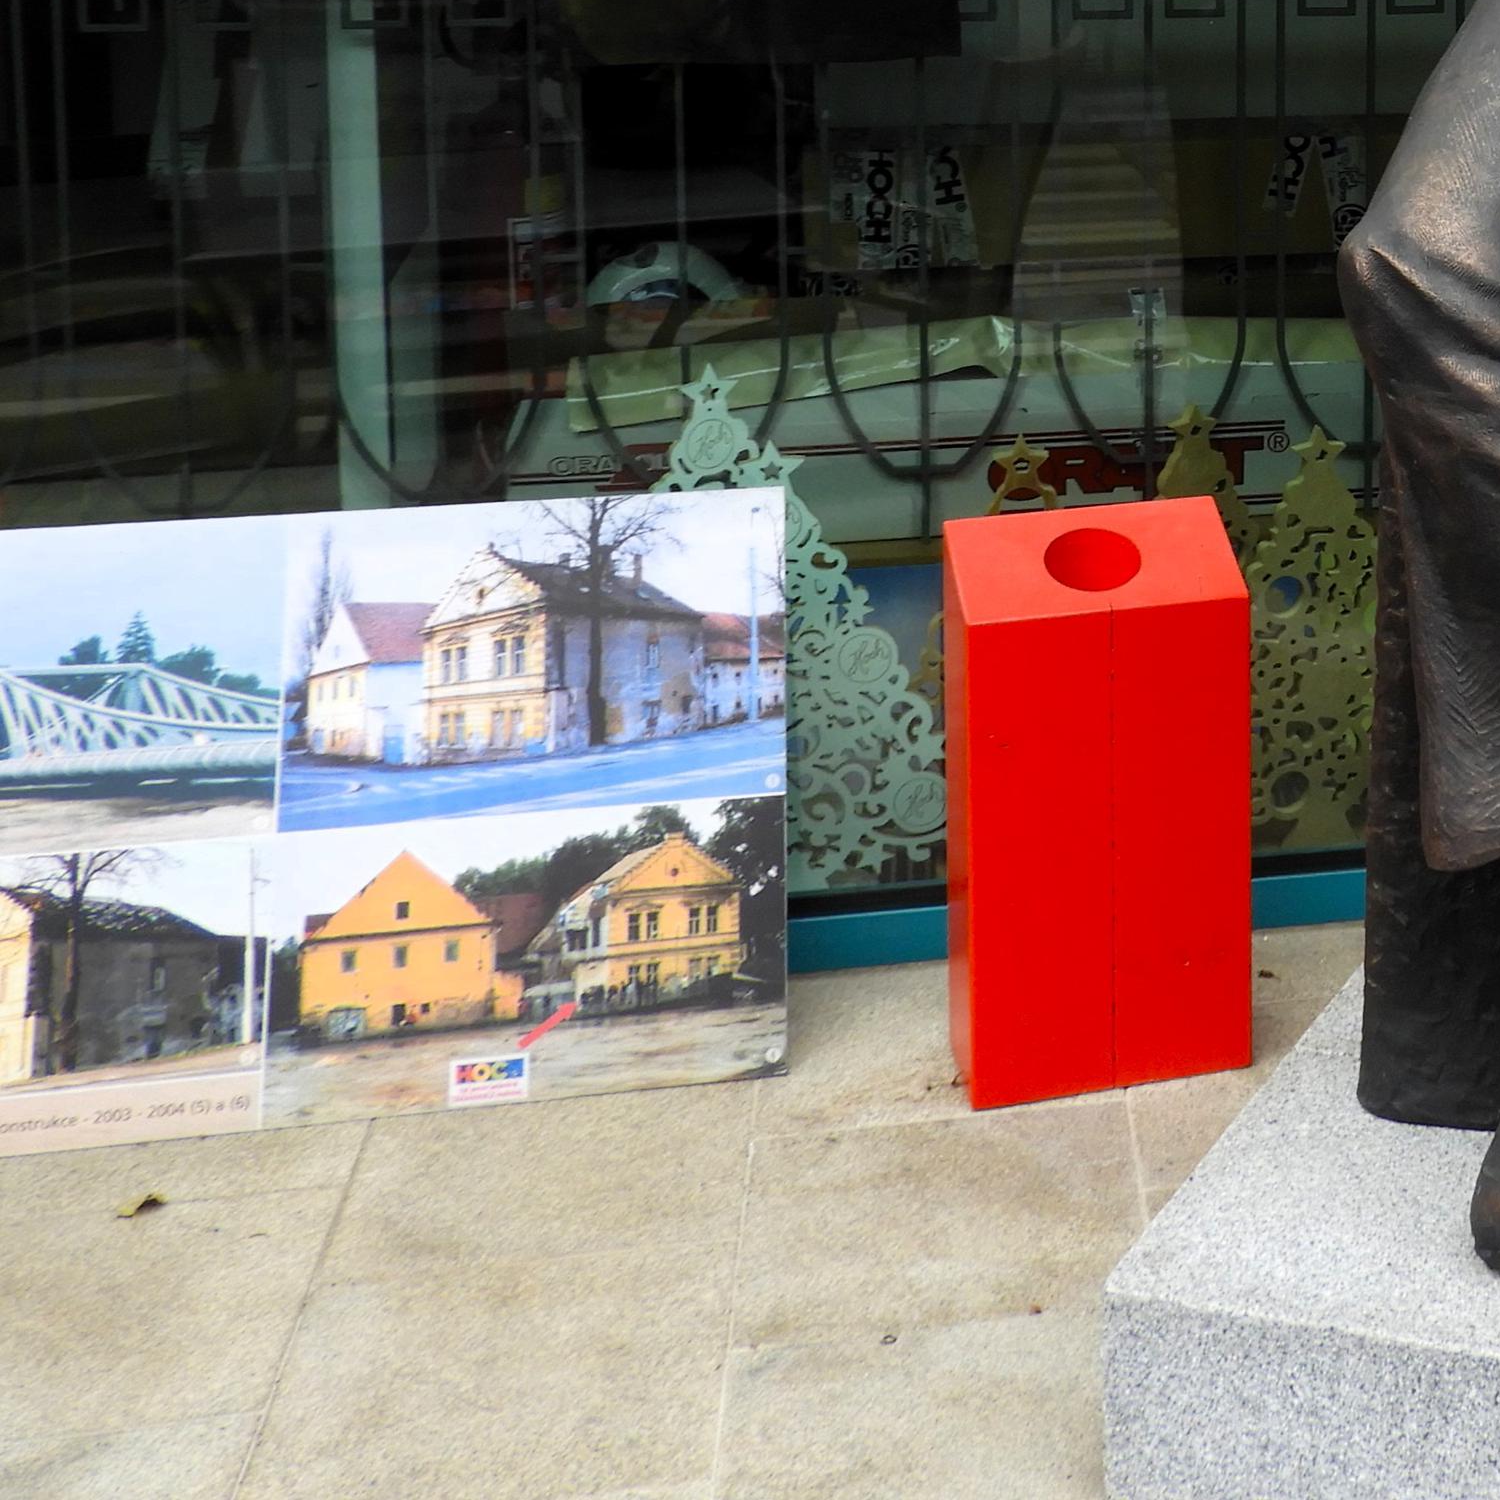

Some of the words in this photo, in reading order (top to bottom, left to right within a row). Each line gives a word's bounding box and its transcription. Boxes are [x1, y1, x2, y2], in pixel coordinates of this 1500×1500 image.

[863, 149, 895, 243] HOCH
[93, 1107, 132, 1124] 2003
[147, 1102, 186, 1119] 2004
